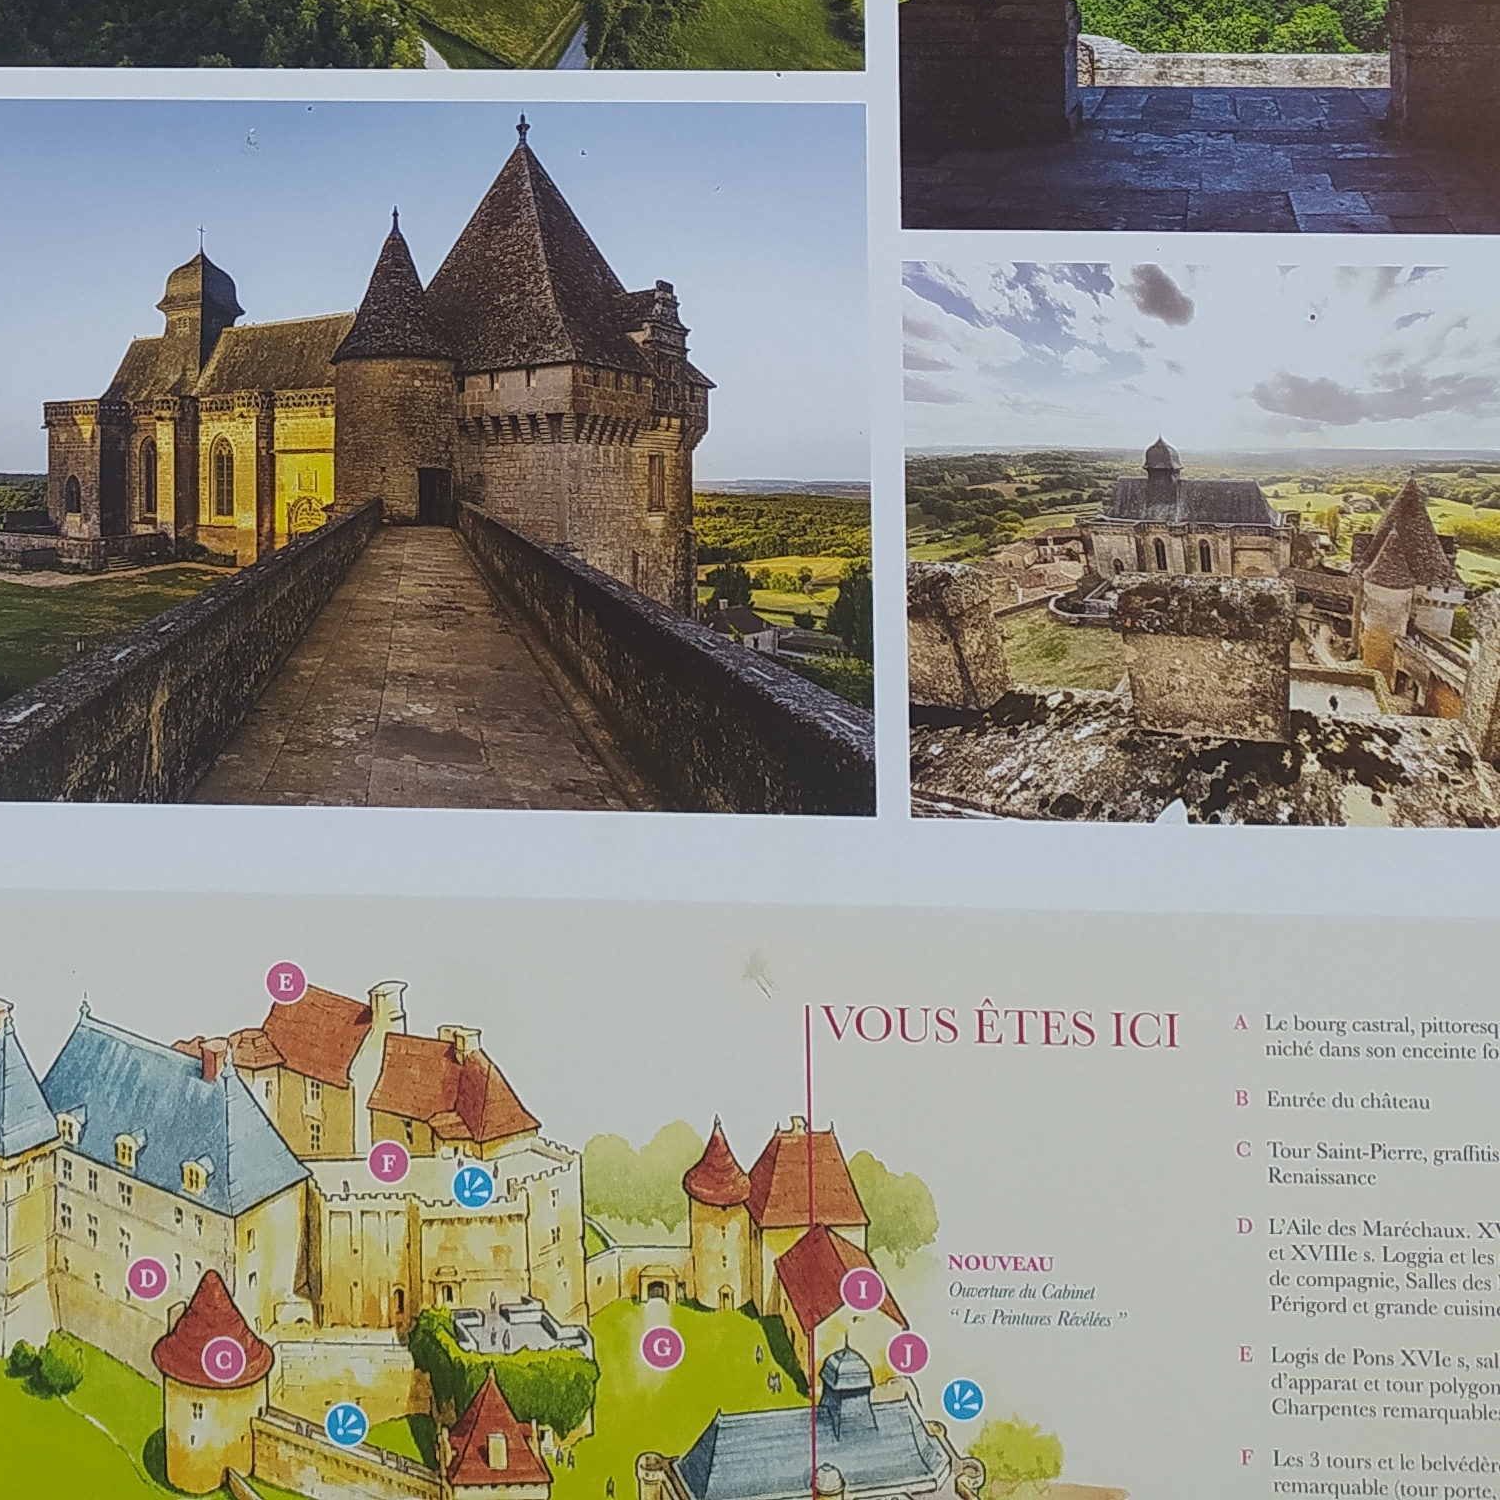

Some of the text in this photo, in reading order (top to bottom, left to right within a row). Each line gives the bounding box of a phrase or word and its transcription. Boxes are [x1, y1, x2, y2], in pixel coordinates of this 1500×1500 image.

[279, 973, 293, 991] E
[820, 997, 1180, 1048] VOUS ÊTES ICI
[1233, 1013, 1248, 1030] A
[1265, 1013, 1288, 1031] Le
[1293, 1014, 1348, 1037] bourg
[1351, 1016, 1415, 1036] castral,
[1265, 1039, 1477, 1060] niché dans son enceinte
[1235, 1089, 1431, 1110] B Entrée du château
[382, 1155, 396, 1172] F
[1236, 1140, 1500, 1166] C Tour Saint-Pierre, graffitis
[1268, 1166, 1377, 1186] Renaissance
[1236, 1217, 1471, 1239] D L'Aile des Maréchaux.
[948, 1254, 1054, 1272] NOUVEAU
[1268, 1244, 1495, 1269] et XVIIIe Loggia et les
[139, 1269, 157, 1288] D
[1268, 1269, 1492, 1293] de compagnie, Salles des
[858, 1281, 868, 1299] I
[949, 1281, 1096, 1300] Ouverture du Cabinet
[1270, 1294, 1438, 1319] Périgord et grande
[963, 1308, 1112, 1327] Les Peintures Révélées
[653, 1338, 671, 1356] G
[900, 1344, 912, 1368] J
[1239, 1345, 1452, 1369] E Logis de Pons XVIe
[216, 1351, 231, 1369] C
[1270, 1372, 1424, 1396] d'apparat et tour
[1271, 1397, 1377, 1422] Charpentes
[1240, 1448, 1415, 1471] F Les 3 tours et le
